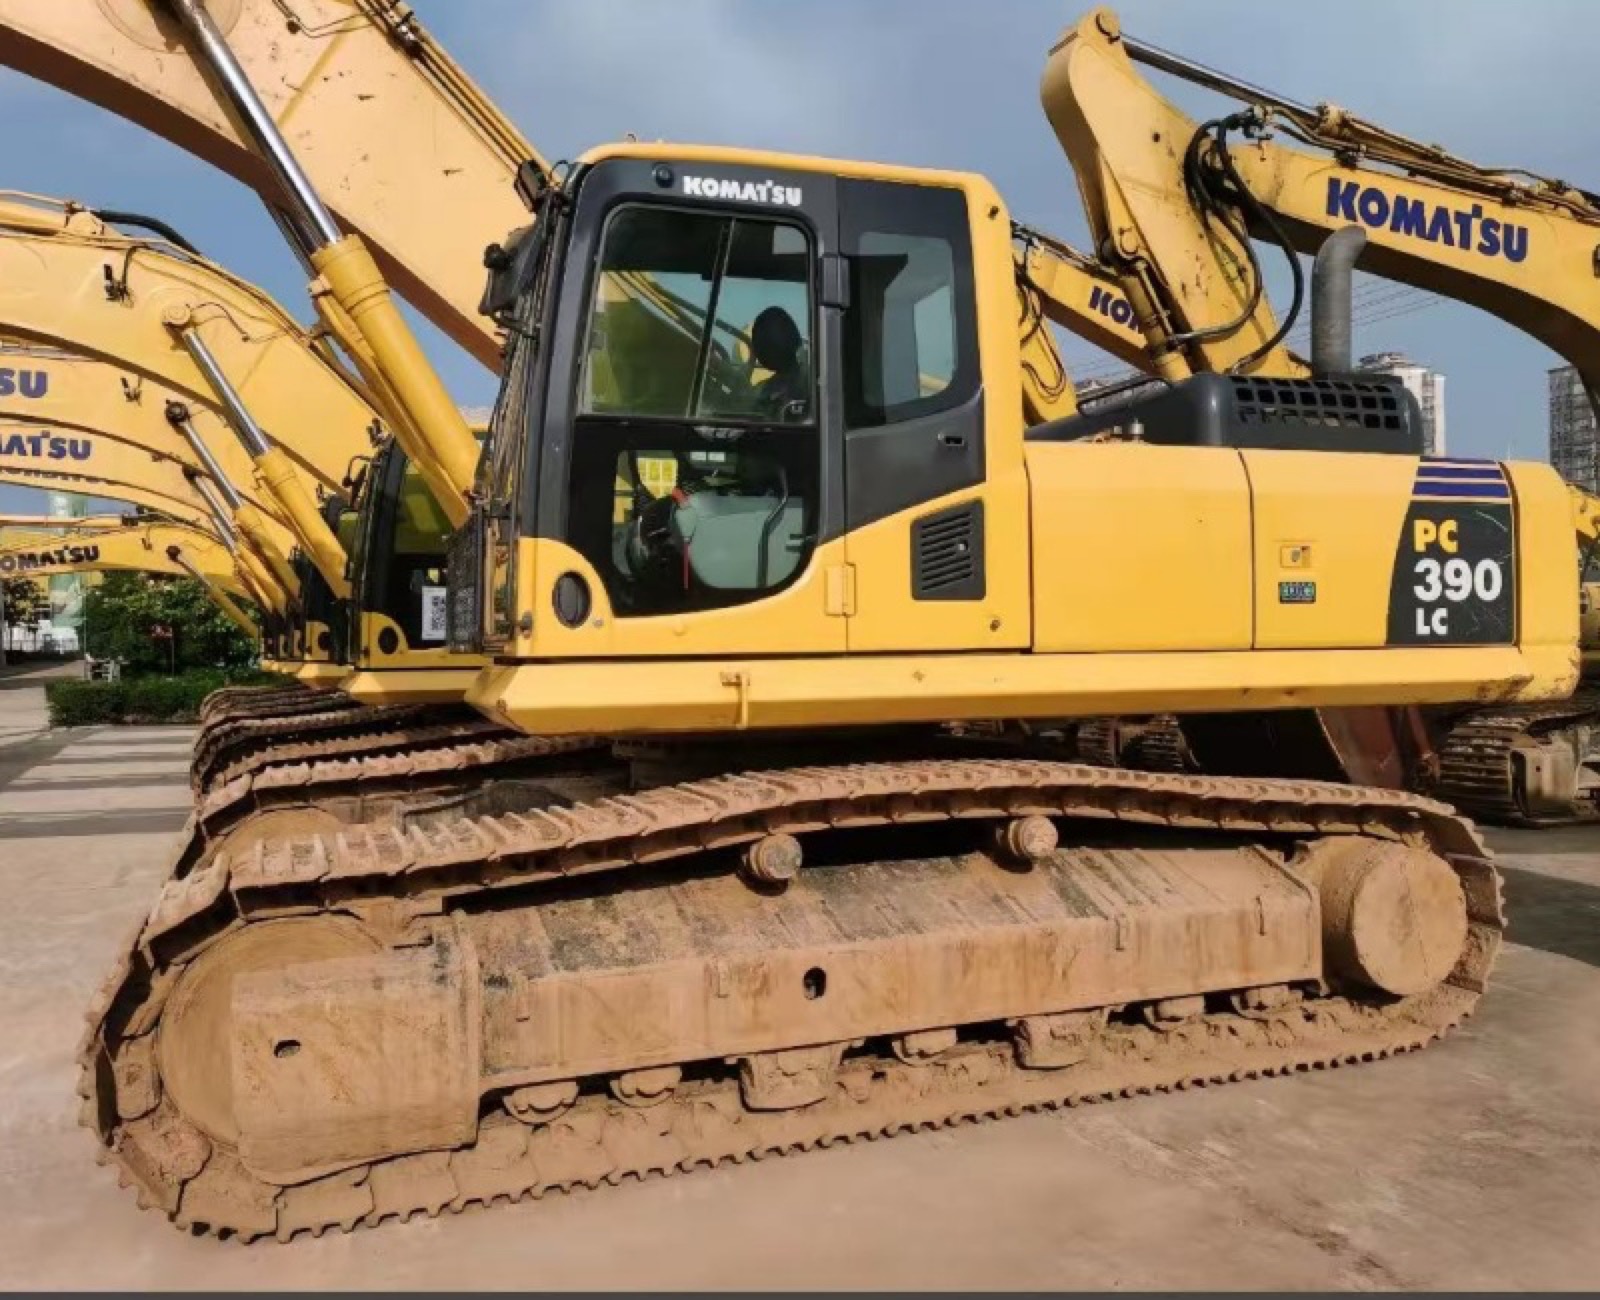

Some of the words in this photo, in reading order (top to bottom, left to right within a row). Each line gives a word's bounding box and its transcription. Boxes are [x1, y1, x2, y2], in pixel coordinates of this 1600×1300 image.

[682, 176, 802, 206] KOMATSU
[1326, 176, 1529, 263] KOMATSU
[0, 368, 48, 398] SU
[0, 431, 92, 460] ATSU
[1413, 519, 1459, 553] PC
[1413, 558, 1502, 602] 390
[1415, 607, 1449, 636] LC
